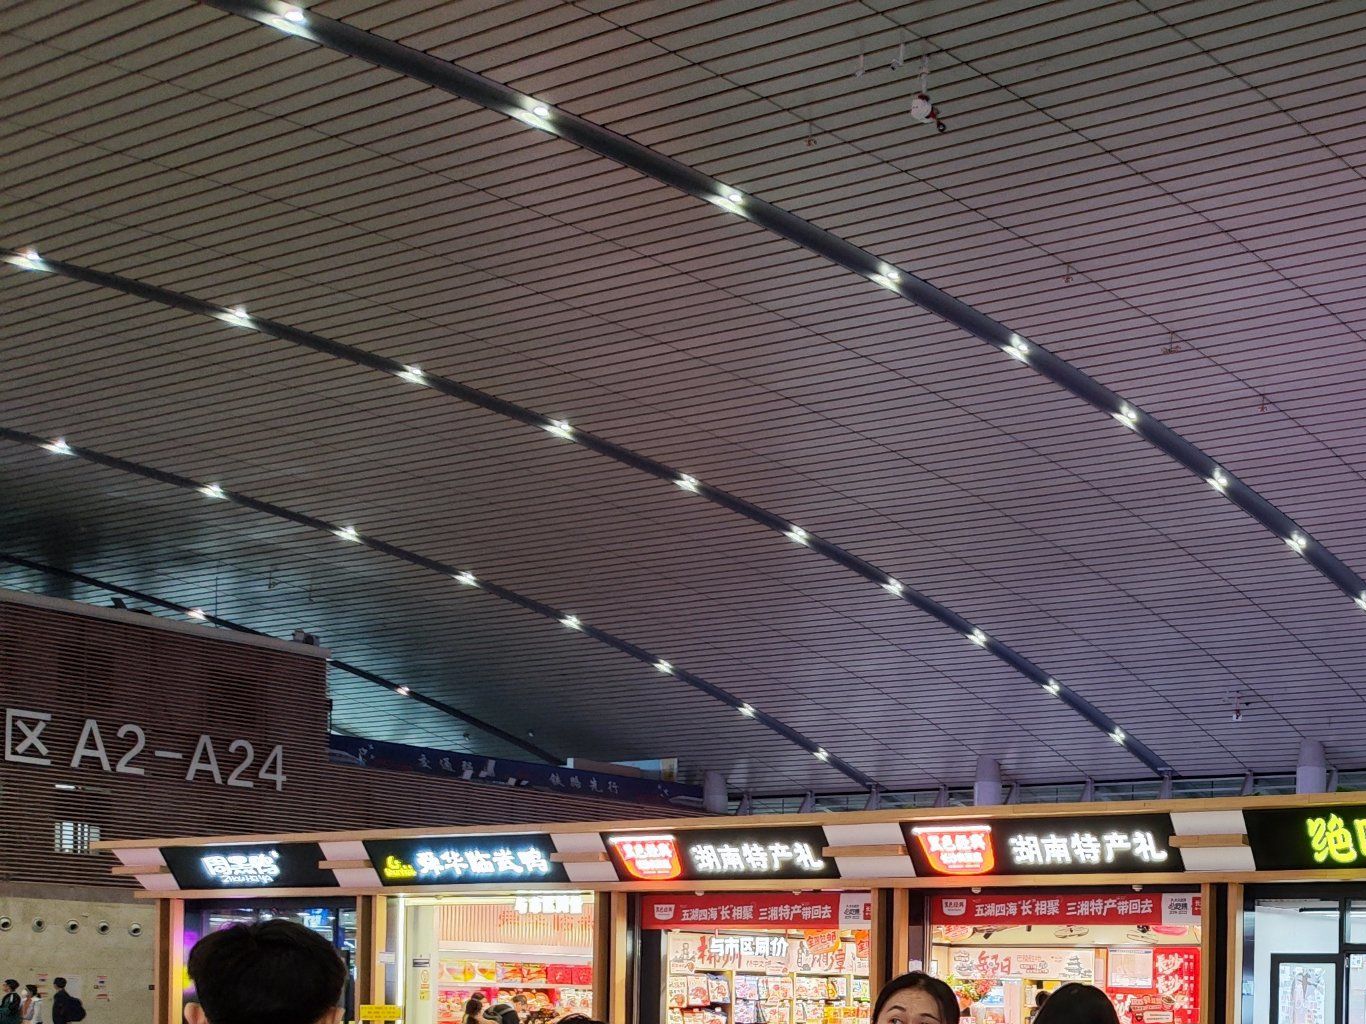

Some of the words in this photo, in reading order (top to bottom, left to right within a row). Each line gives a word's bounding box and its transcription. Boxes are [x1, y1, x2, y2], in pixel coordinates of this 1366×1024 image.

[5, 708, 51, 766] 区
[70, 718, 287, 792] A2-A24
[689, 842, 825, 871] 湖南特产礼
[1008, 831, 1168, 865] 湖南特产礼
[758, 904, 832, 921] 三湘特产带回去
[1065, 898, 1153, 916] 三湘特产带回去
[709, 936, 789, 957] 与市区同价
